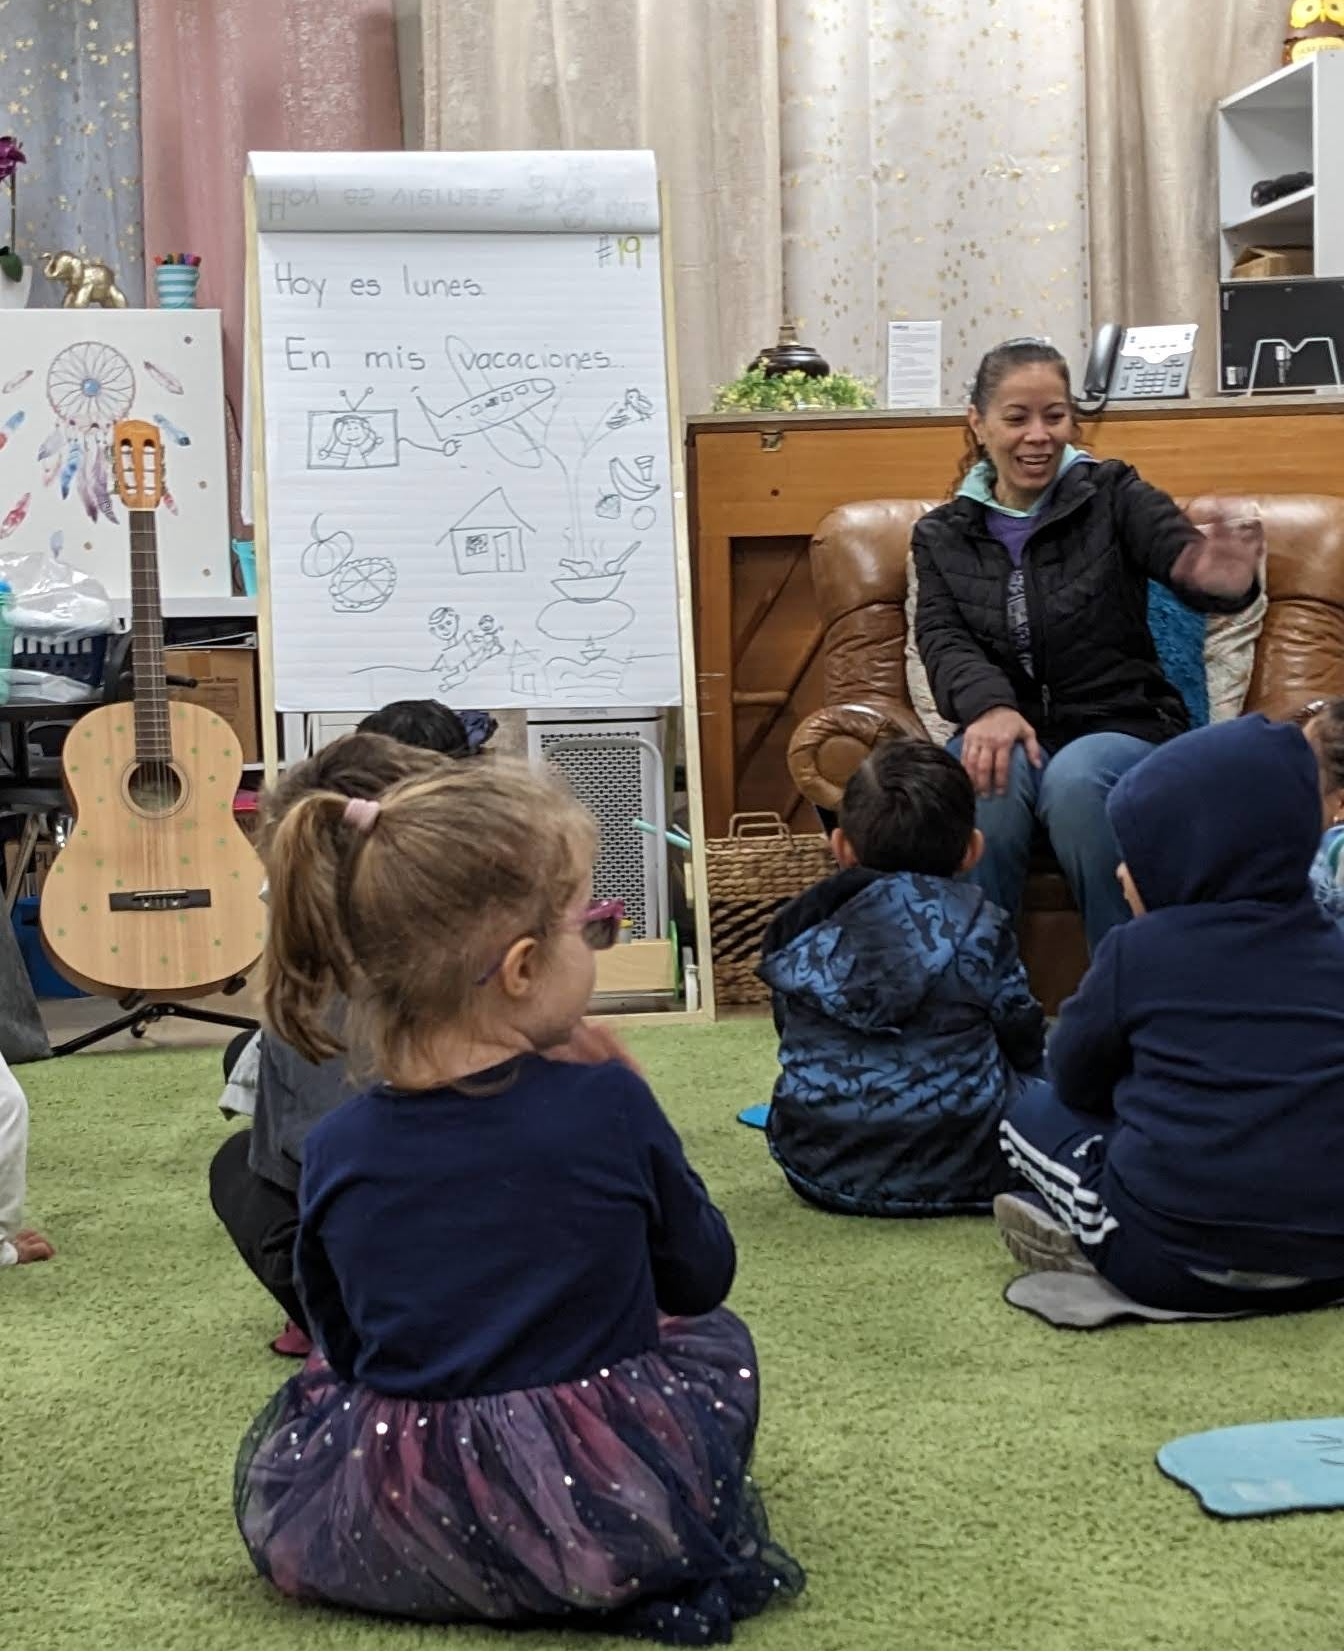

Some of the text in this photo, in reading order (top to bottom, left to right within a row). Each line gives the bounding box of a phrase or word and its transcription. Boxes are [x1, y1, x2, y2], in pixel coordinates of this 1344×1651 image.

[595, 234, 643, 270] #19
[275, 262, 327, 308] Hoy
[350, 277, 382, 297] es
[283, 336, 331, 372] En
[365, 345, 426, 371] mis
